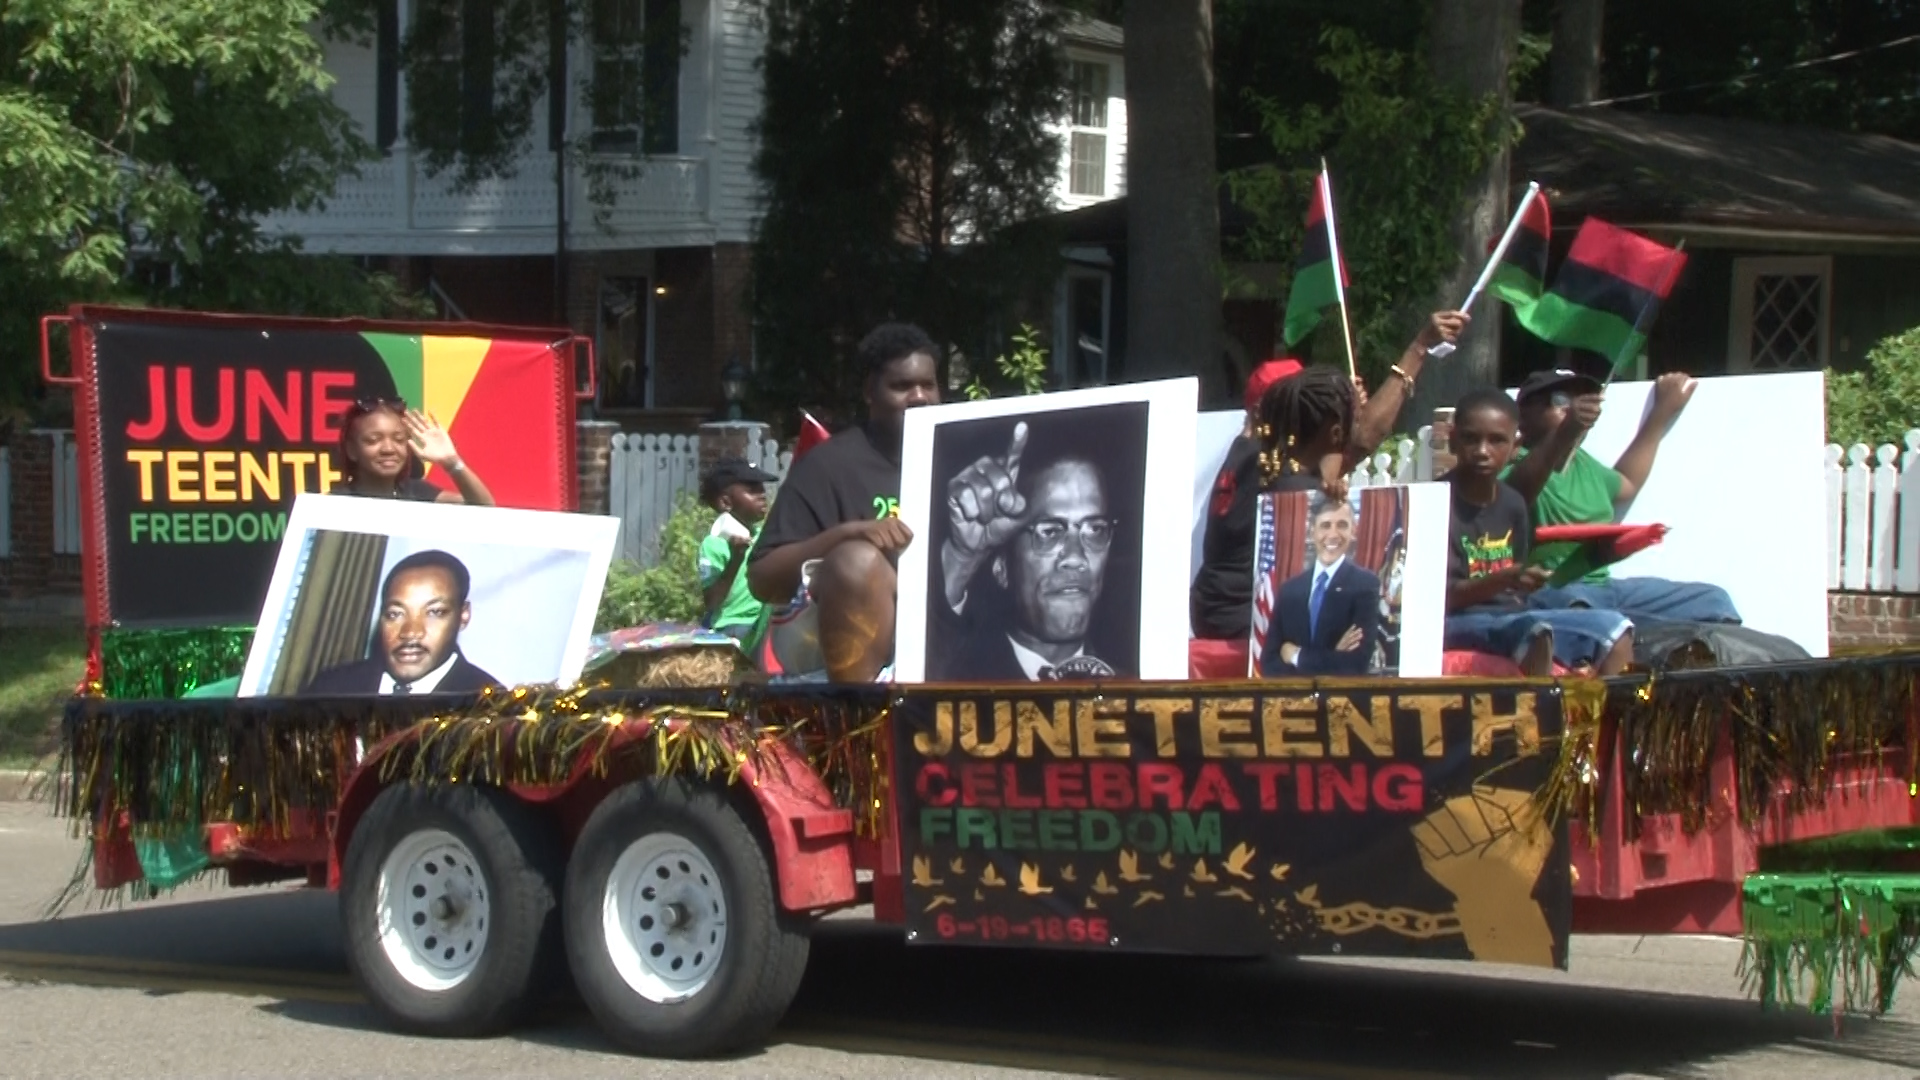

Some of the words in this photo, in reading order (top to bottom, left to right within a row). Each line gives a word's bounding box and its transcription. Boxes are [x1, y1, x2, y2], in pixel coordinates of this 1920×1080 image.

[126, 365, 356, 442] JUNE
[129, 511, 288, 543] FREEDOM
[912, 692, 1540, 759] JUNETEENTH
[915, 761, 1424, 812] CELEBRATING
[919, 808, 1222, 855] FREEDOM
[936, 912, 1109, 944] 6-19-1865
